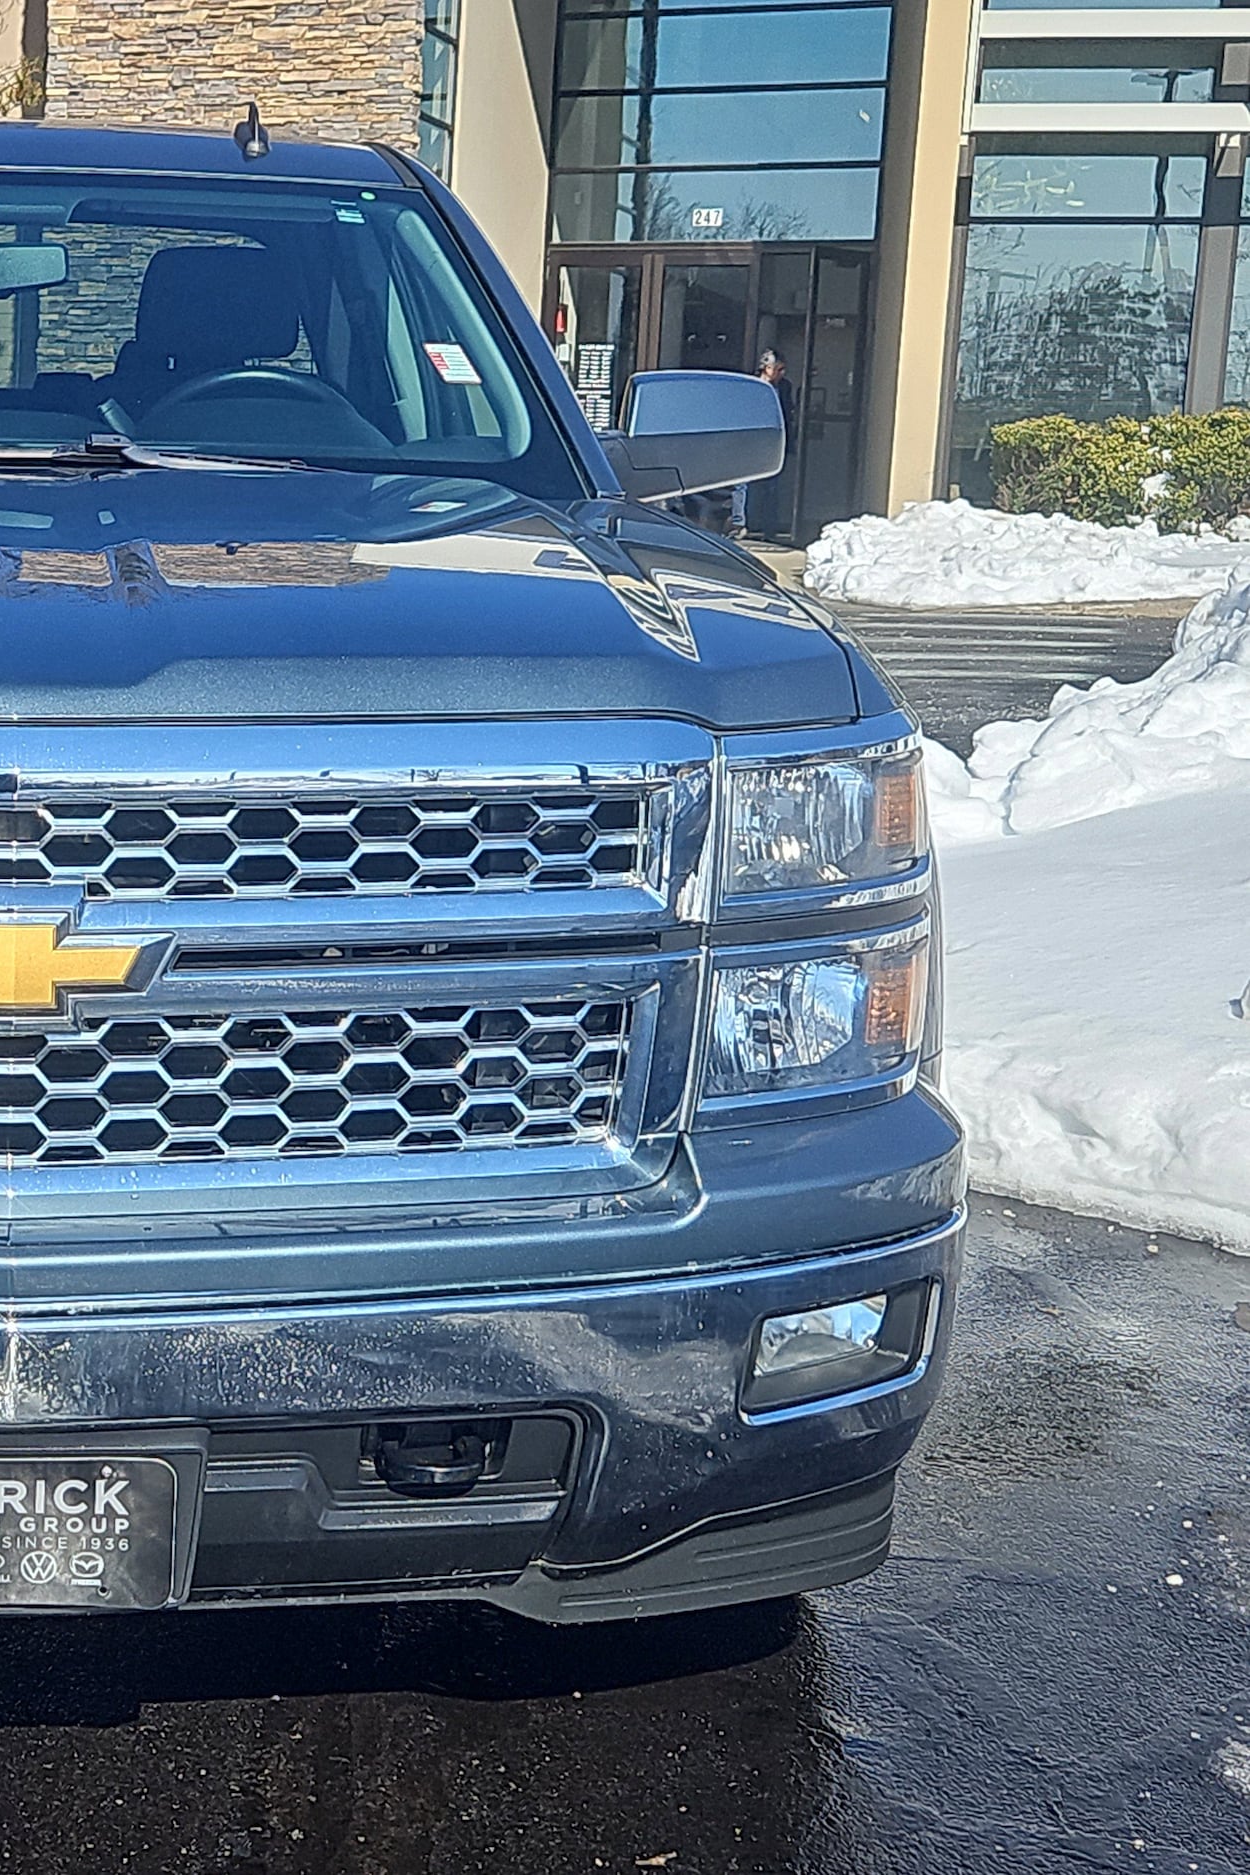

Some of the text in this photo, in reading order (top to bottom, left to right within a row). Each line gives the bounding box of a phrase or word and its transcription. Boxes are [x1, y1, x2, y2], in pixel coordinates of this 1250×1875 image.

[694, 210, 721, 225] 247
[19, 1516, 130, 1535] GROUP
[1, 1536, 69, 1550] SINCE
[79, 1537, 130, 1551] 1936
